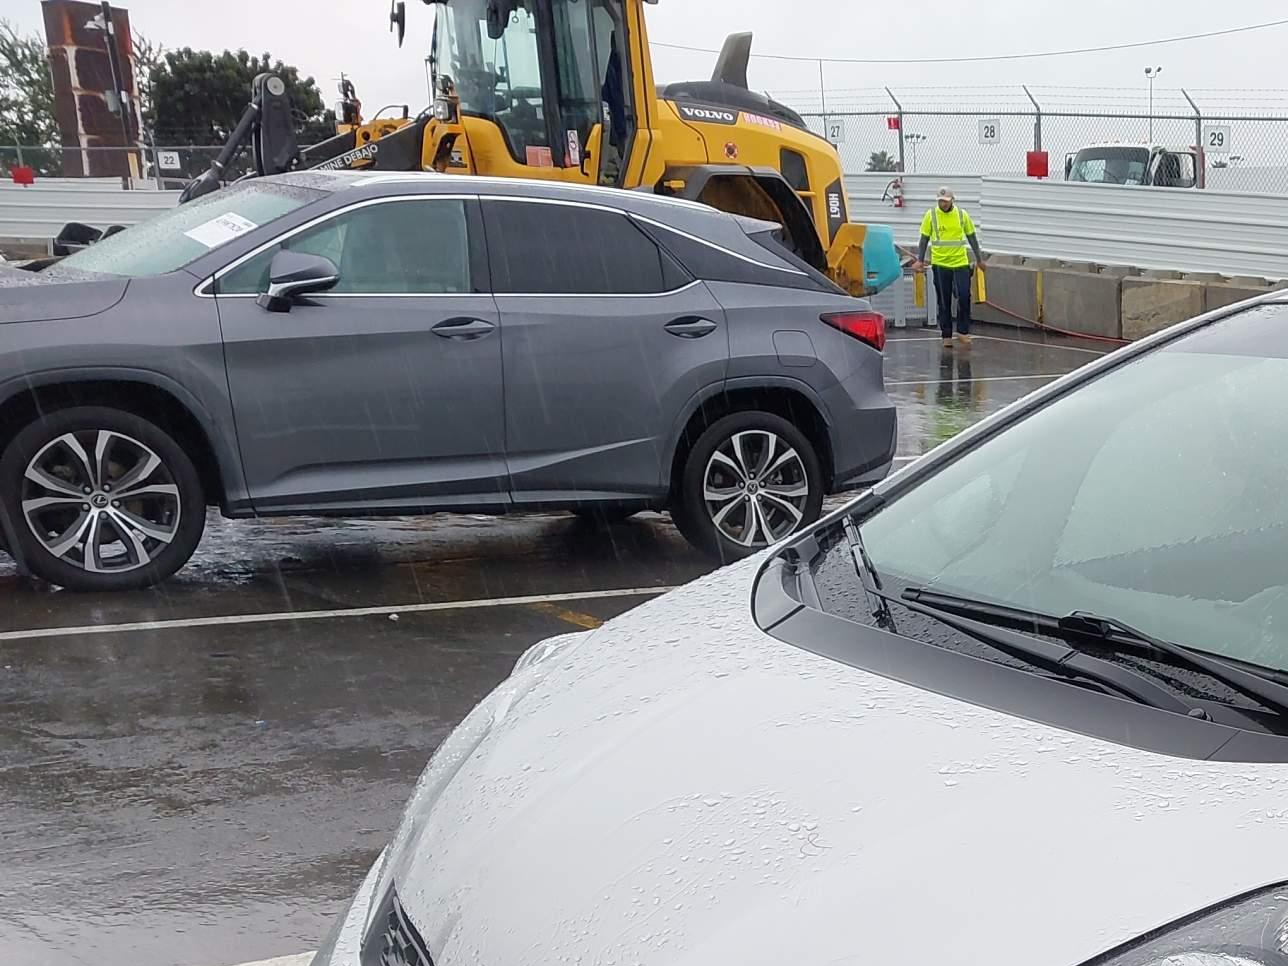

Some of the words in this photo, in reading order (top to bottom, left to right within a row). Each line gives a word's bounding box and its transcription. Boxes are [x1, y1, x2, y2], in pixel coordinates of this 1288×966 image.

[682, 107, 734, 121] VOLVO
[830, 126, 840, 138] 27
[983, 125, 996, 138] 28
[1209, 132, 1224, 146] 29
[163, 156, 175, 165] 22
[343, 143, 378, 165] DEBAJO
[828, 193, 840, 218] L90H
